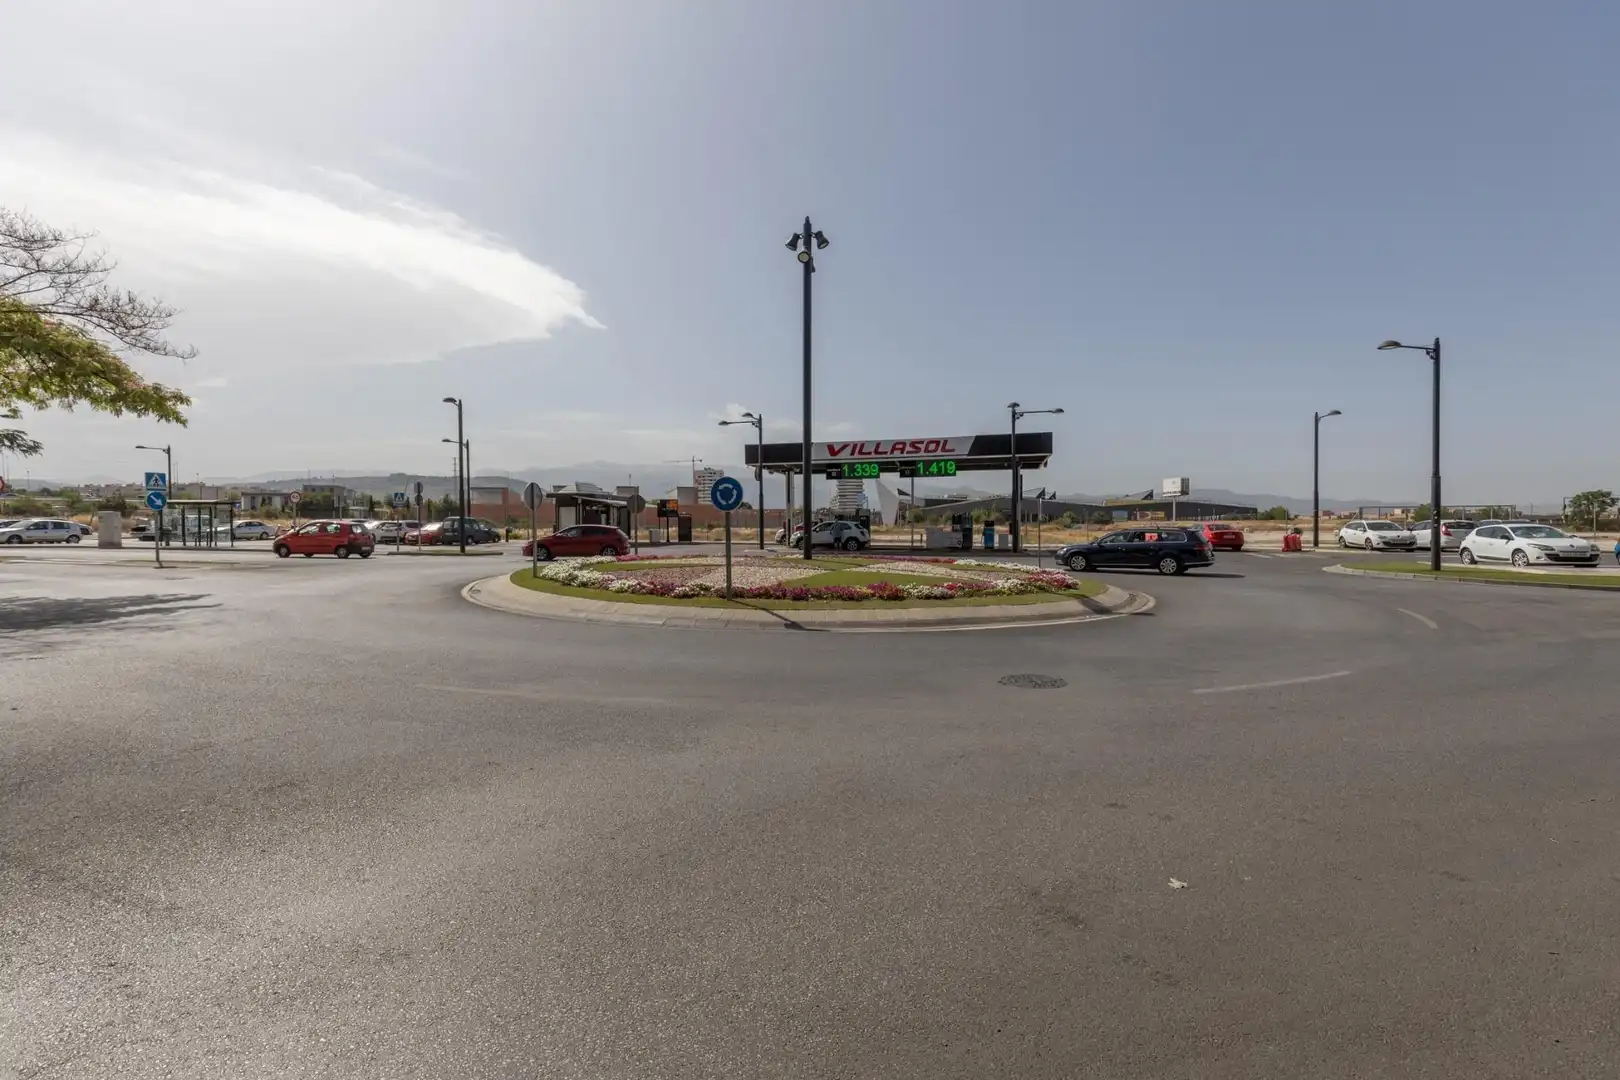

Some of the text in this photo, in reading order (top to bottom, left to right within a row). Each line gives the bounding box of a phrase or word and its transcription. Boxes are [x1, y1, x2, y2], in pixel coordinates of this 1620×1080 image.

[827, 440, 956, 456] VILLASOL
[842, 463, 879, 477] 1.339
[917, 461, 956, 475] 1.419
